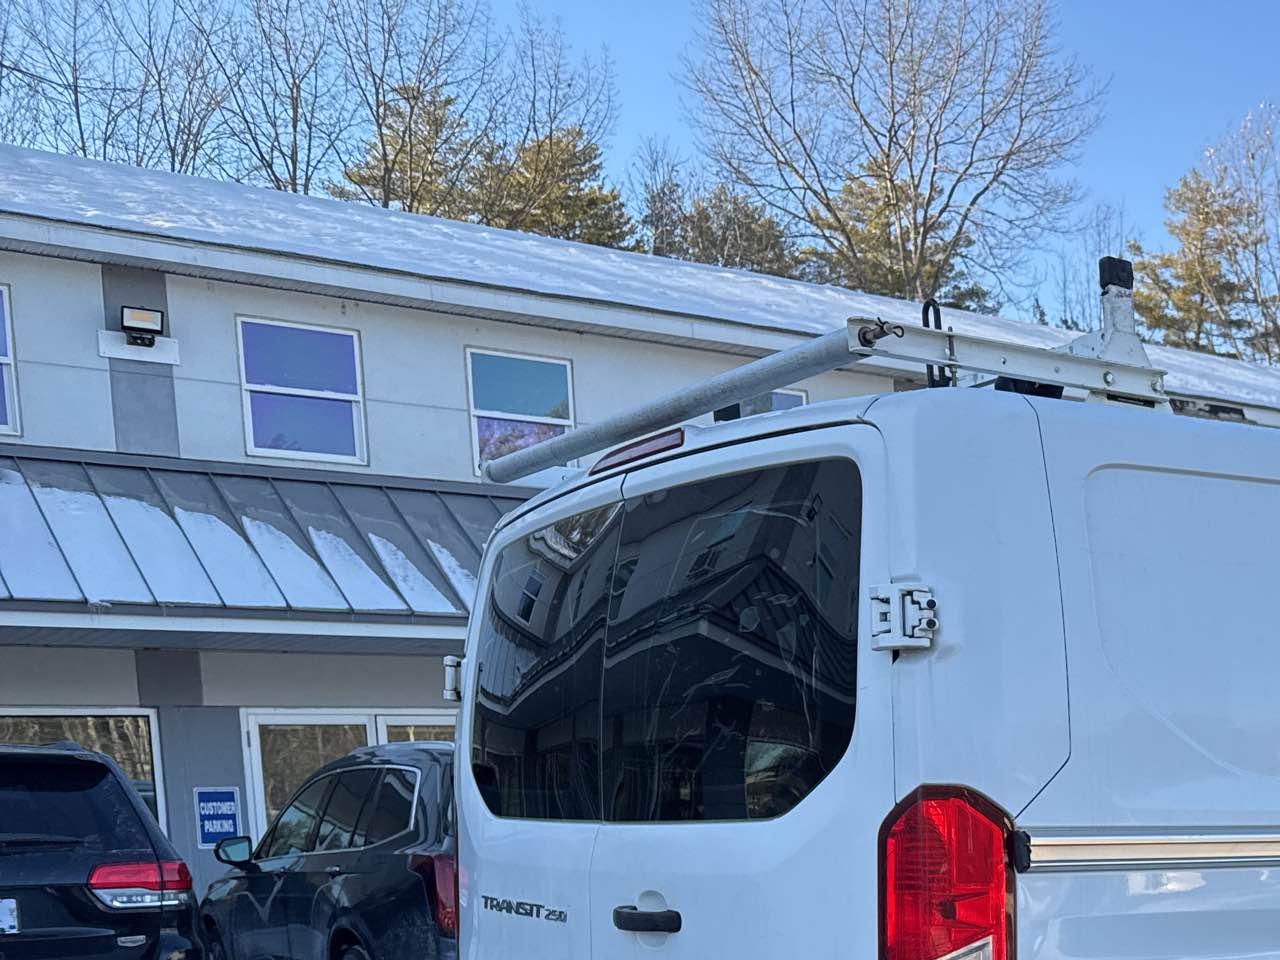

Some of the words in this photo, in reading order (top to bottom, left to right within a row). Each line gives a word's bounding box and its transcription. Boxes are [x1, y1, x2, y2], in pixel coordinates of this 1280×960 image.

[200, 801, 235, 815] CUSTOMER
[204, 820, 234, 833] PARKING
[481, 895, 545, 918] TRANSIT
[544, 908, 568, 923] 250
